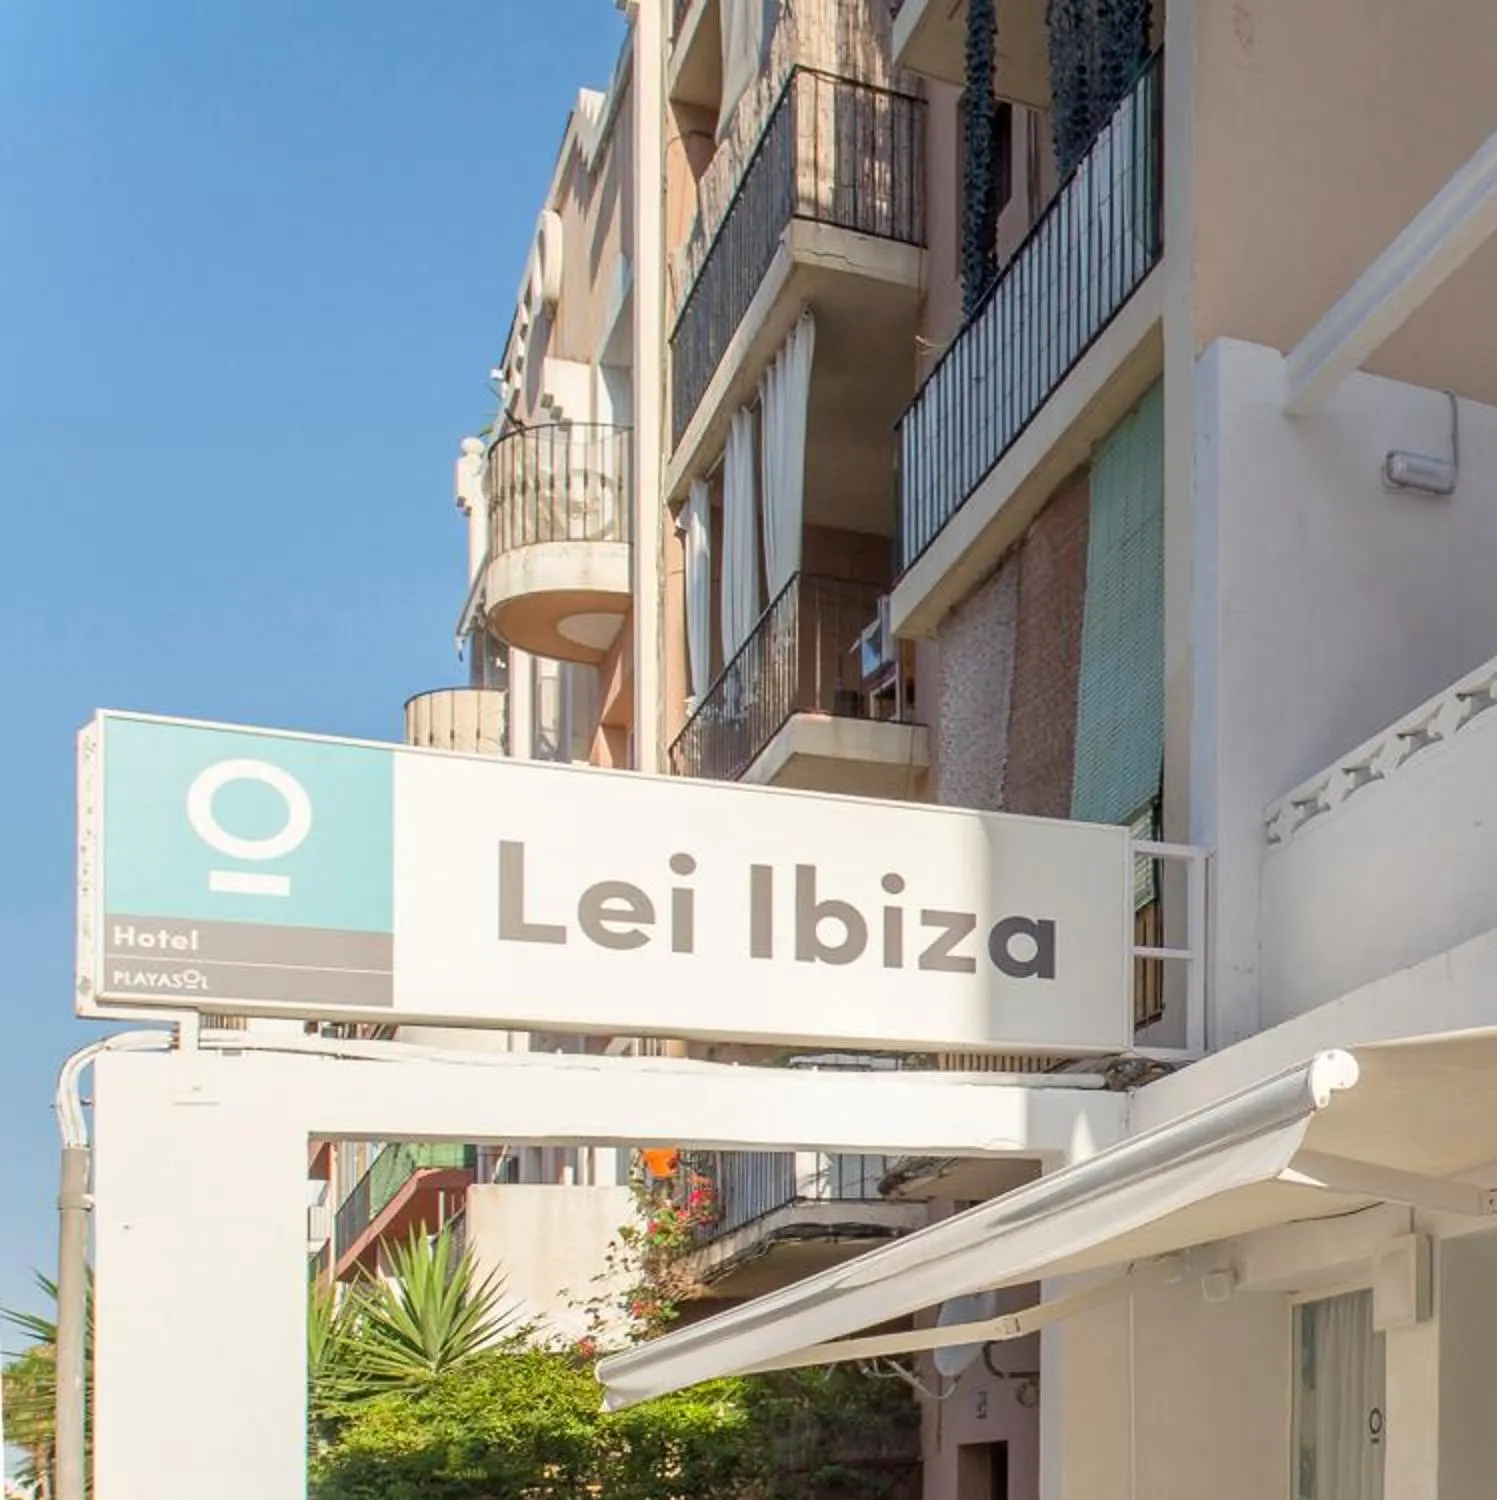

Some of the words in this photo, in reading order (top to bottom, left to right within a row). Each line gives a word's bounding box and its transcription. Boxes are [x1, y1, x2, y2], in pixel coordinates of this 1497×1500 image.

[498, 840, 697, 954] Lei
[750, 864, 1056, 980] Ibiza
[113, 926, 198, 950] Hotel
[113, 969, 209, 990] PLAYASOL
